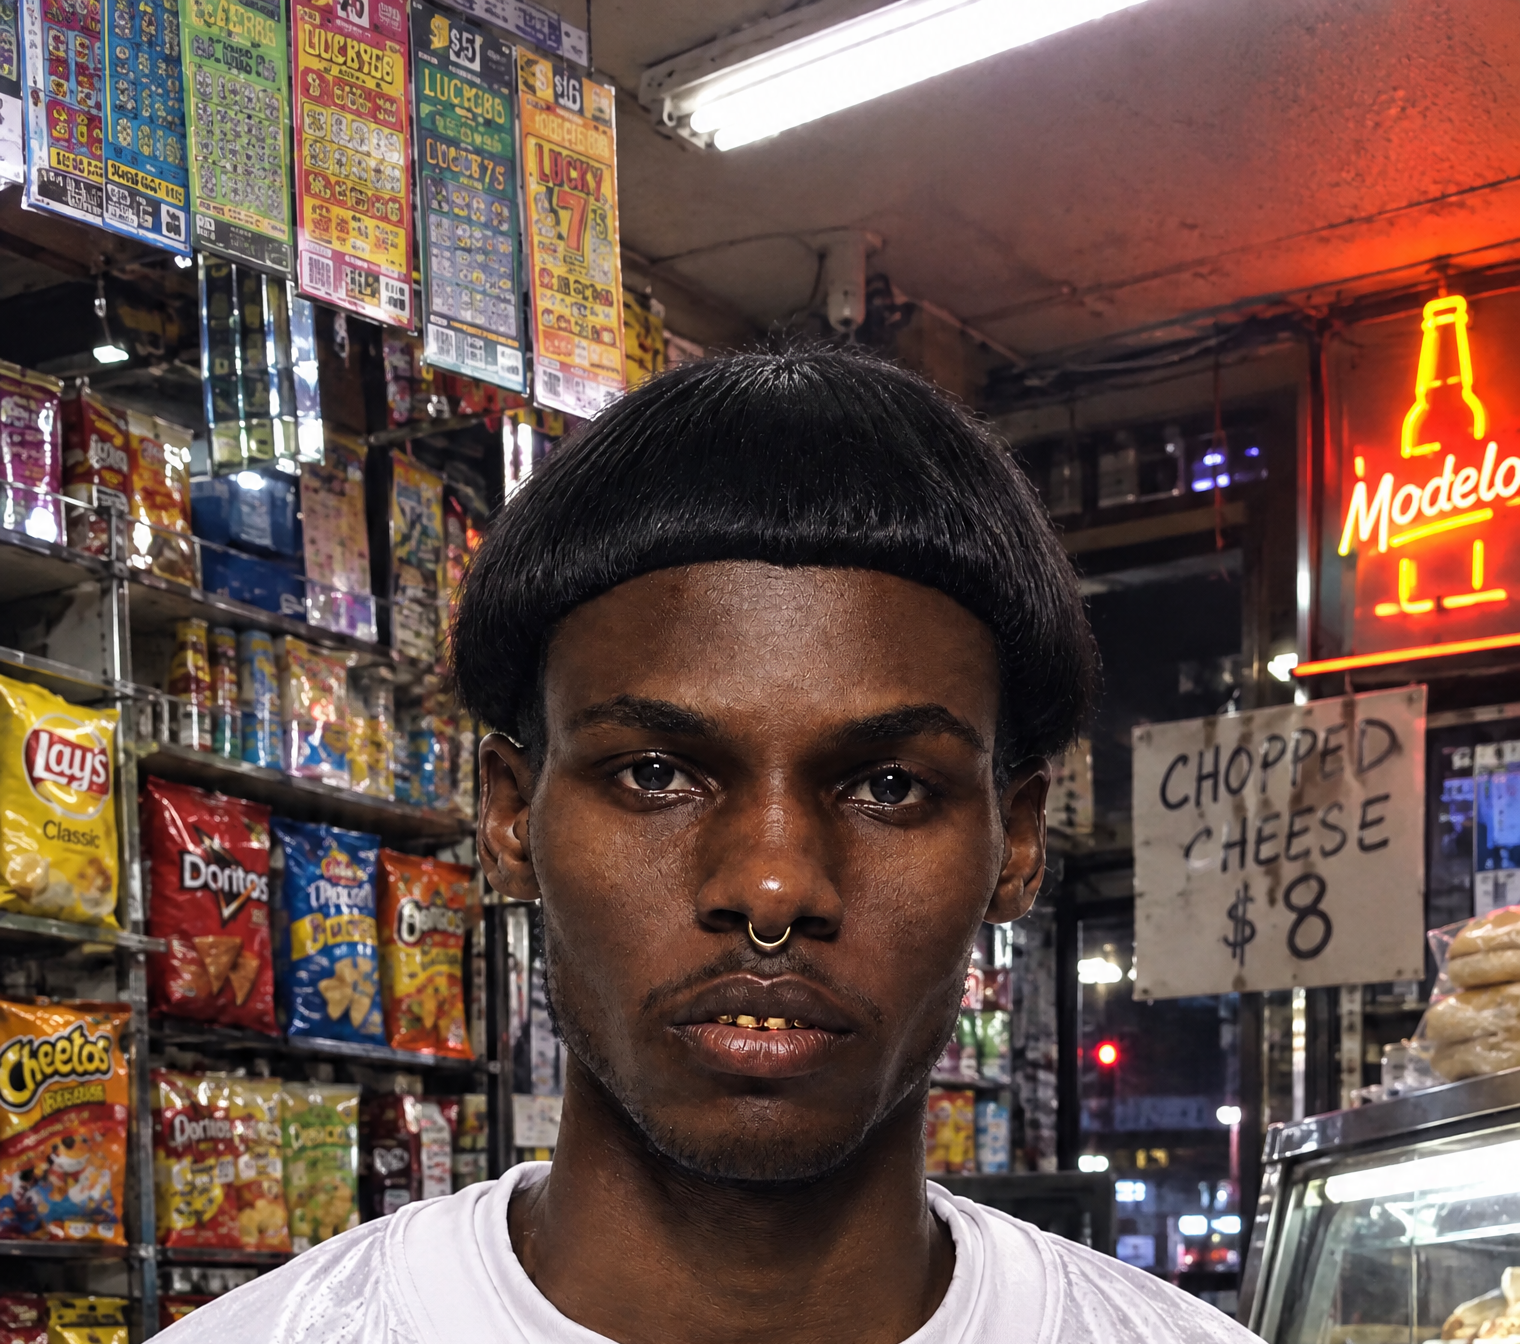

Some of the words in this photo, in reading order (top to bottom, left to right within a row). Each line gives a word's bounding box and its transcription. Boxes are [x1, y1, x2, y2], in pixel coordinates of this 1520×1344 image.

[534, 141, 604, 203] LUCKY
[1338, 440, 1520, 556] Modelo
[1159, 718, 1403, 811] CHOPPED
[43, 819, 101, 850] Classic
[1183, 793, 1391, 875] CHEESE
[182, 851, 270, 903] Doritos
[0, 1024, 112, 1106] Cheetos
